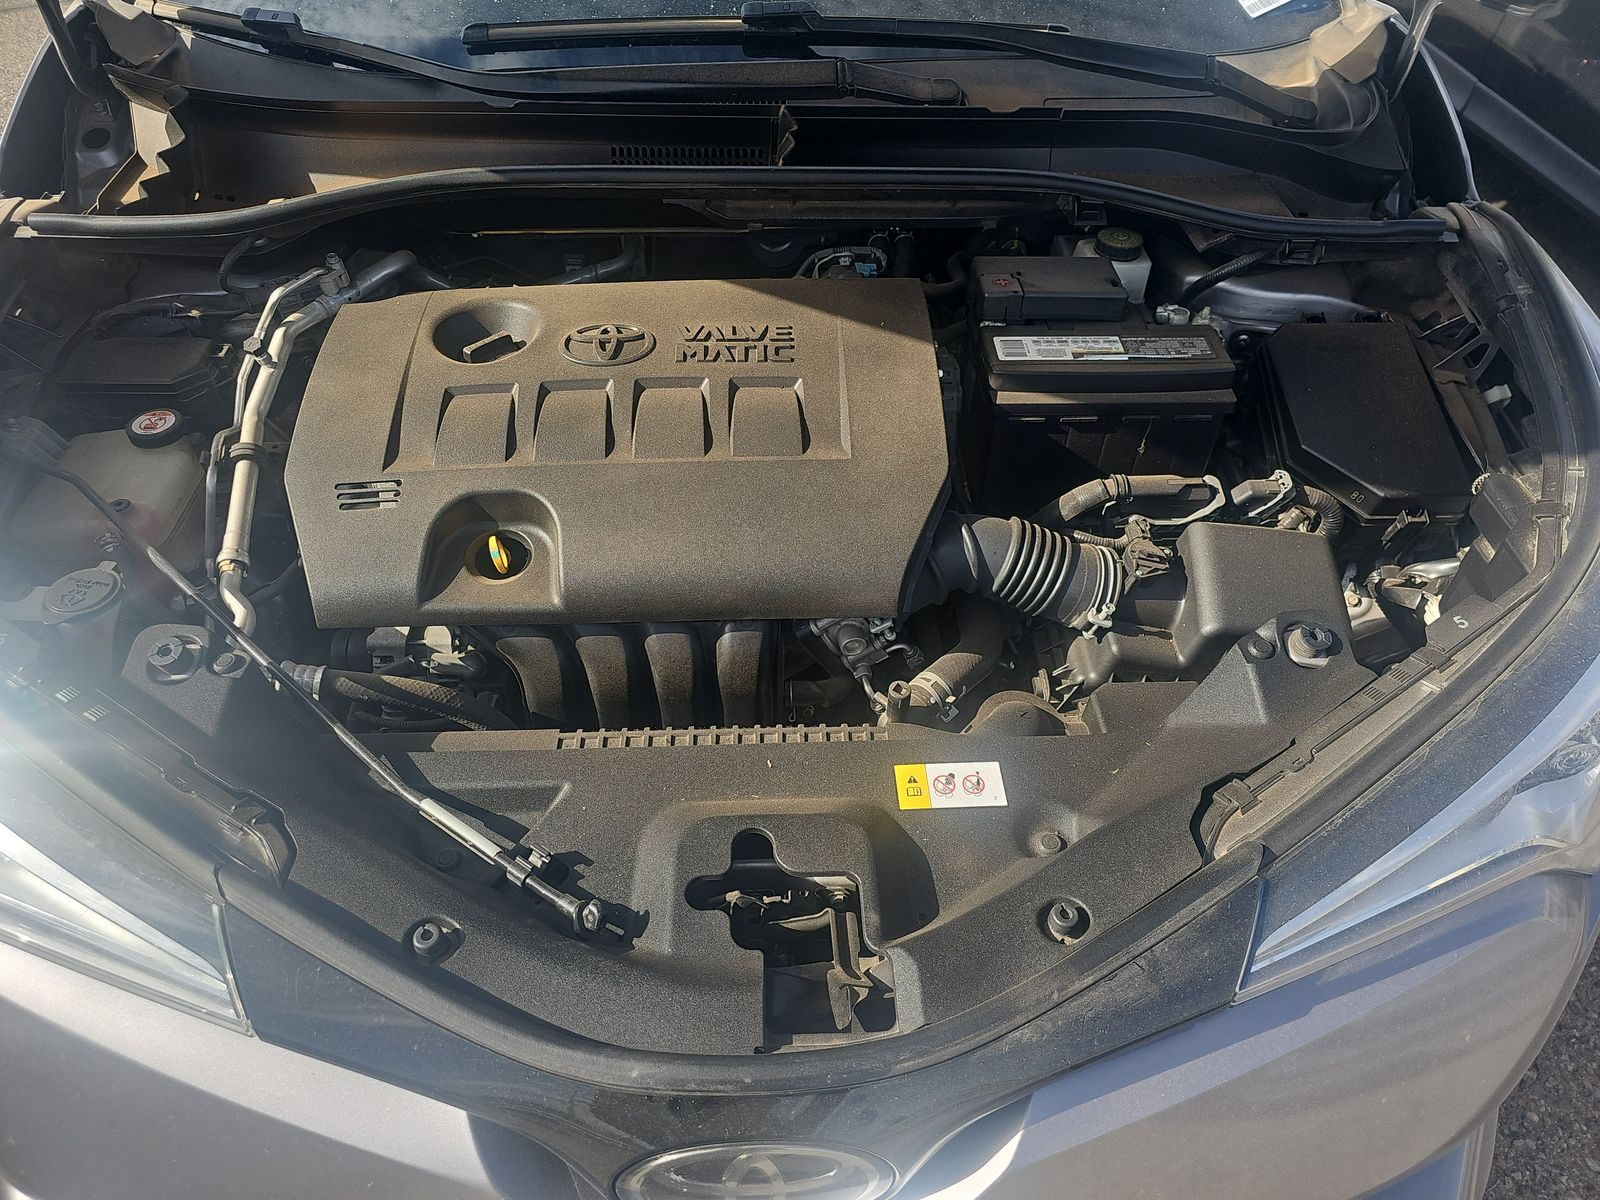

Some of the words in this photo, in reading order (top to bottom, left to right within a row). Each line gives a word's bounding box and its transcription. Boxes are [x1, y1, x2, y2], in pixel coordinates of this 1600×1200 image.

[676, 324, 795, 342] VALVE
[675, 343, 795, 363] MATIC
[1453, 615, 1468, 628] 5
